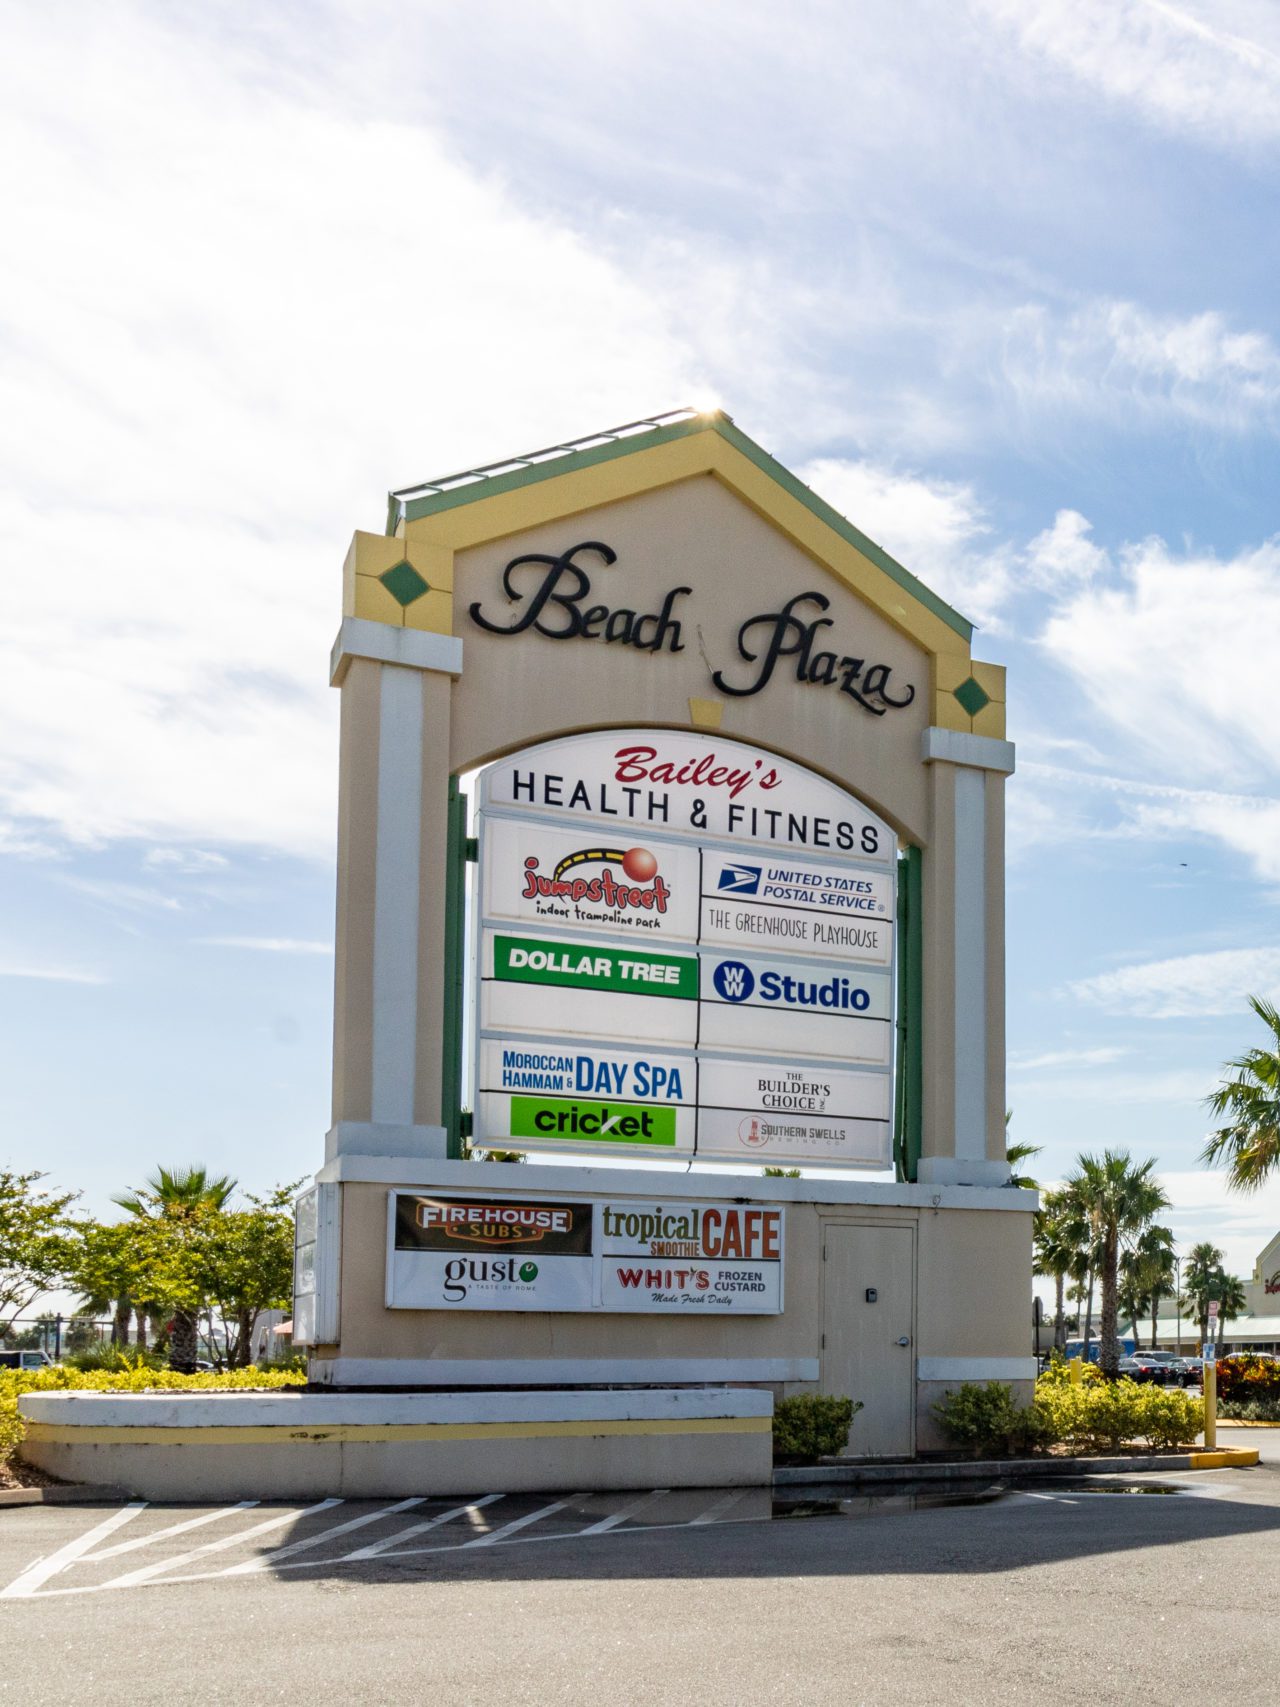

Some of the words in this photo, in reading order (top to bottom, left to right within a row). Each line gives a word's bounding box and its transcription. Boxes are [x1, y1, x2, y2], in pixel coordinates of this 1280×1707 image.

[469, 541, 693, 653] Beach
[712, 591, 915, 716] Plaza
[614, 746, 782, 799] Bailey's
[512, 770, 669, 822] HEALTH
[689, 799, 707, 829] &
[728, 804, 879, 854] FITNESS
[767, 869, 822, 886] UNITED
[824, 876, 873, 893] STATES
[763, 885, 817, 903] POSTAL
[819, 893, 877, 911] SERVICE
[536, 901, 570, 918] indoor
[575, 905, 633, 925] trampoline
[636, 917, 661, 929] park
[709, 909, 731, 930] THE
[735, 913, 808, 940] GREENHOUSE
[813, 922, 879, 949] PLAYHOUSE
[508, 948, 612, 977] DOLLAR
[618, 960, 681, 985] TREE
[759, 971, 870, 1011] Studio
[503, 1050, 574, 1073] MOROCCAN
[502, 1069, 564, 1091] HAMMAM
[566, 1077, 573, 1089] &
[575, 1056, 628, 1095] DAY
[633, 1061, 683, 1100] SPA
[758, 1079, 831, 1097] BUILDER'S
[786, 1072, 803, 1081] THE
[762, 1094, 816, 1110] CHOICE
[534, 1106, 654, 1138] cricket
[761, 1124, 807, 1138] SOUTHERN
[809, 1128, 846, 1141] SWELLS
[422, 1207, 568, 1233] FIREHOUSE
[470, 1224, 522, 1238] SUBS
[603, 1205, 700, 1244] tropical
[651, 1241, 699, 1257] SMOOTHIE
[702, 1209, 780, 1258] CAFE
[617, 1267, 709, 1290] WHIT'S
[714, 1281, 766, 1292] CUSTARD
[718, 1271, 762, 1282] FROZEN
[651, 1293, 679, 1303] Made
[681, 1294, 705, 1305] Fresh
[708, 1294, 732, 1305] Daily
